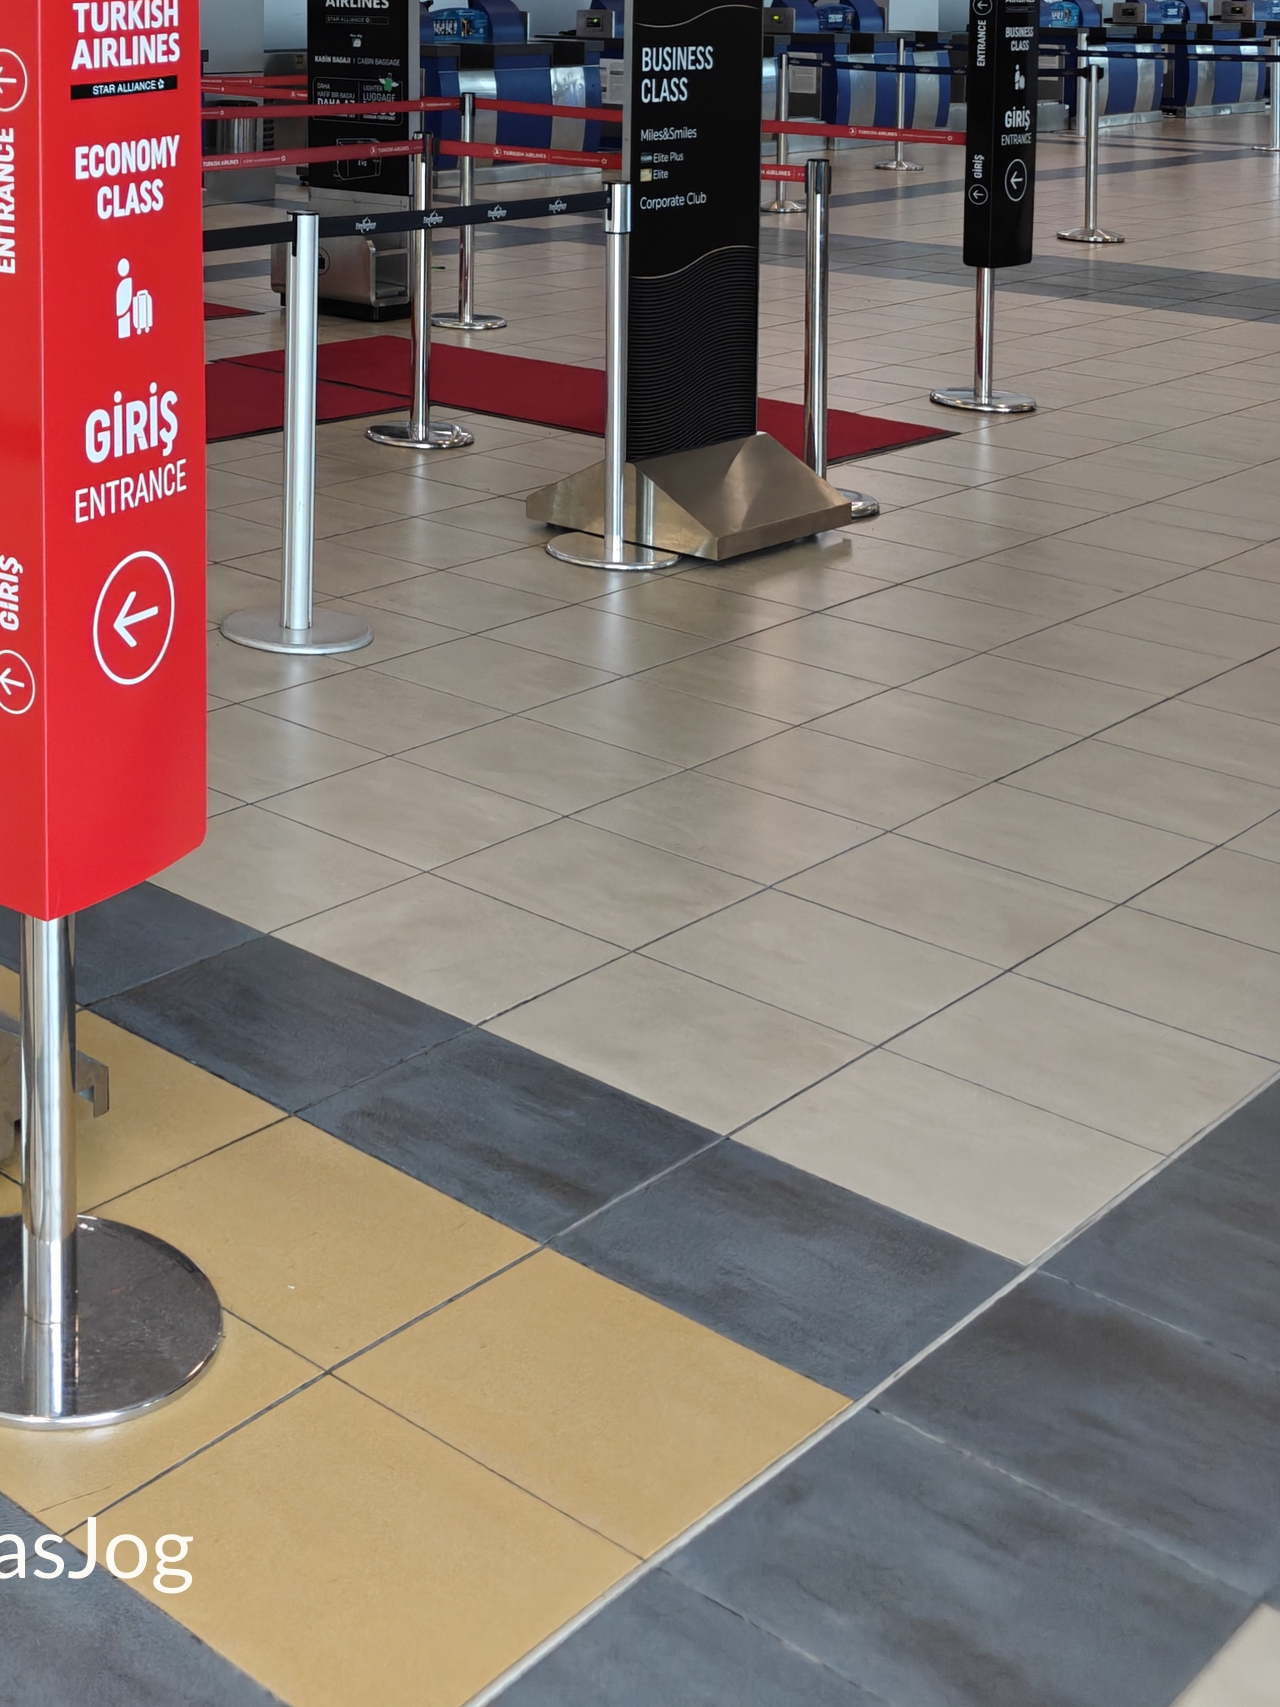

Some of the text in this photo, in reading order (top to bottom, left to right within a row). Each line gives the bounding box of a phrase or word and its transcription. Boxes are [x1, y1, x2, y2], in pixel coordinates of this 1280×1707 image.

[1005, 26, 1034, 38] BUSINESS
[71, 32, 180, 70] AIRLINES
[976, 20, 986, 67] ENTRANCE
[1010, 40, 1029, 52] CLASS
[357, 57, 374, 65] CABIN
[375, 58, 400, 66] BAGGAGE
[642, 46, 714, 72] BUSINESS
[92, 80, 157, 96] STAR ALLIANCE
[641, 77, 688, 103] CLASS
[363, 92, 396, 103] LUGGAGE
[1005, 106, 1030, 131] GİRİŞ
[640, 126, 697, 142] Miles&Smiles
[1001, 133, 1032, 146] ENTRANCE
[75, 135, 180, 180] ECONOMY
[653, 151, 684, 163] Elite Plus
[653, 169, 669, 180] Elite
[766, 169, 791, 177] AIRLINES
[97, 178, 164, 220] CLASS
[640, 192, 707, 211] Corporate Club
[85, 381, 178, 463] GİRİŞ
[75, 459, 187, 524] ENTRANCE
